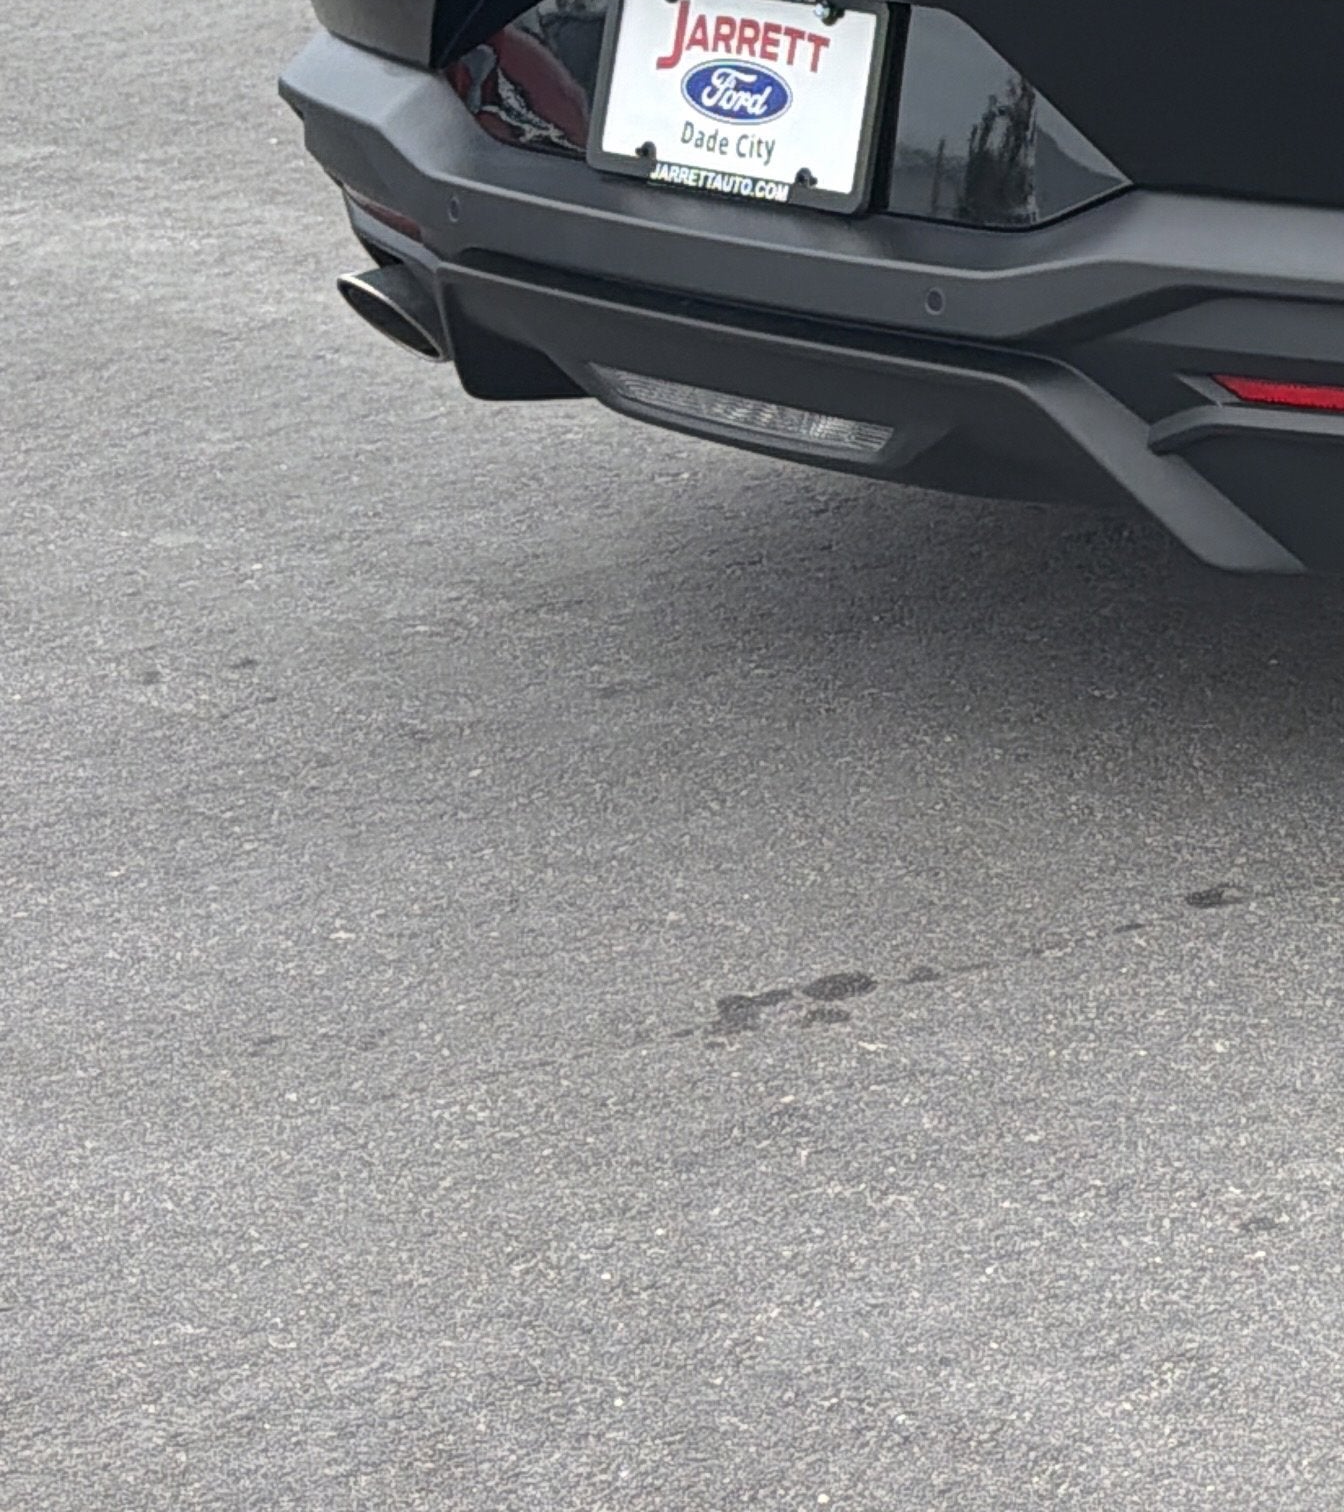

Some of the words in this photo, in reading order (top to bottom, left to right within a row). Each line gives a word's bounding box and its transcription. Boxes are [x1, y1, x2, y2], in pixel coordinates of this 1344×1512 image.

[655, 0, 831, 73] JARRETT
[701, 67, 772, 116] Ford
[680, 121, 729, 155] Dade
[736, 133, 776, 167] City
[650, 162, 790, 202] JARRETTAUTO.COM
